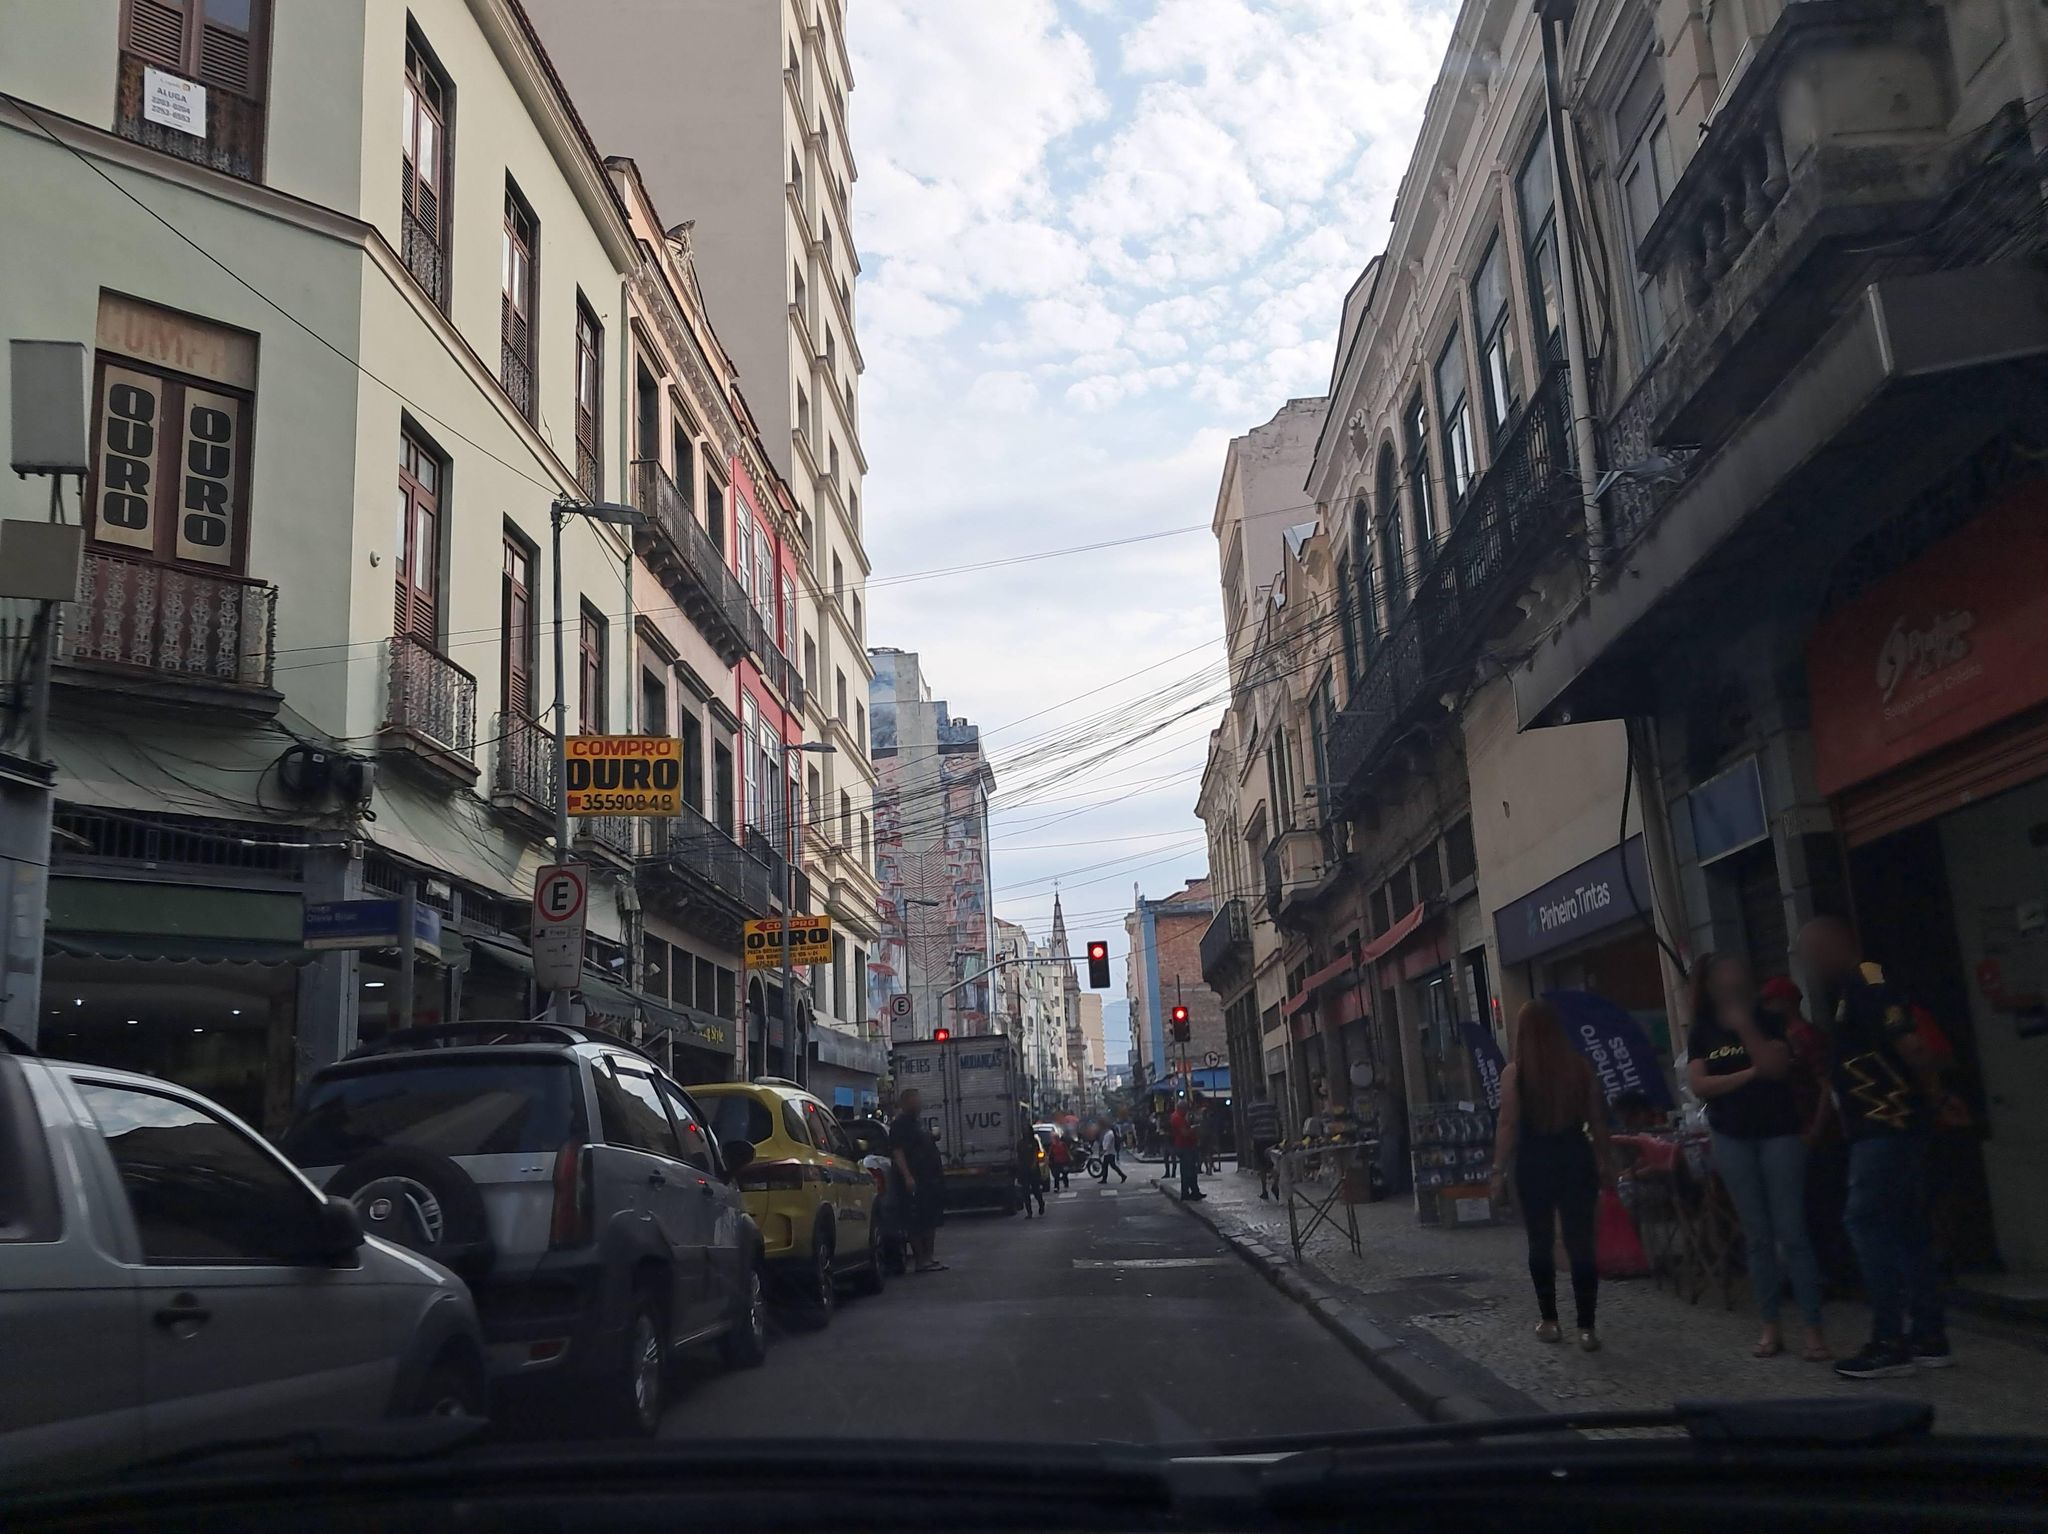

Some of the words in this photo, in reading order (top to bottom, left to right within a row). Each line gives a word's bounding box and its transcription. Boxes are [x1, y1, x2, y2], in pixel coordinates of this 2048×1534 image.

[157, 87, 188, 104] ALUGA
[103, 383, 156, 531] OURO
[184, 405, 231, 547] OURO
[572, 740, 671, 756] COMPRO
[566, 758, 680, 791] OURO
[581, 793, 673, 811] 35590848
[551, 882, 569, 911] E
[1540, 896, 1578, 933] Pinheiro
[1575, 882, 1612, 916] Tintas
[747, 928, 829, 949] OURO
[898, 1000, 905, 1012] E
[966, 1112, 1002, 1130] VUC
